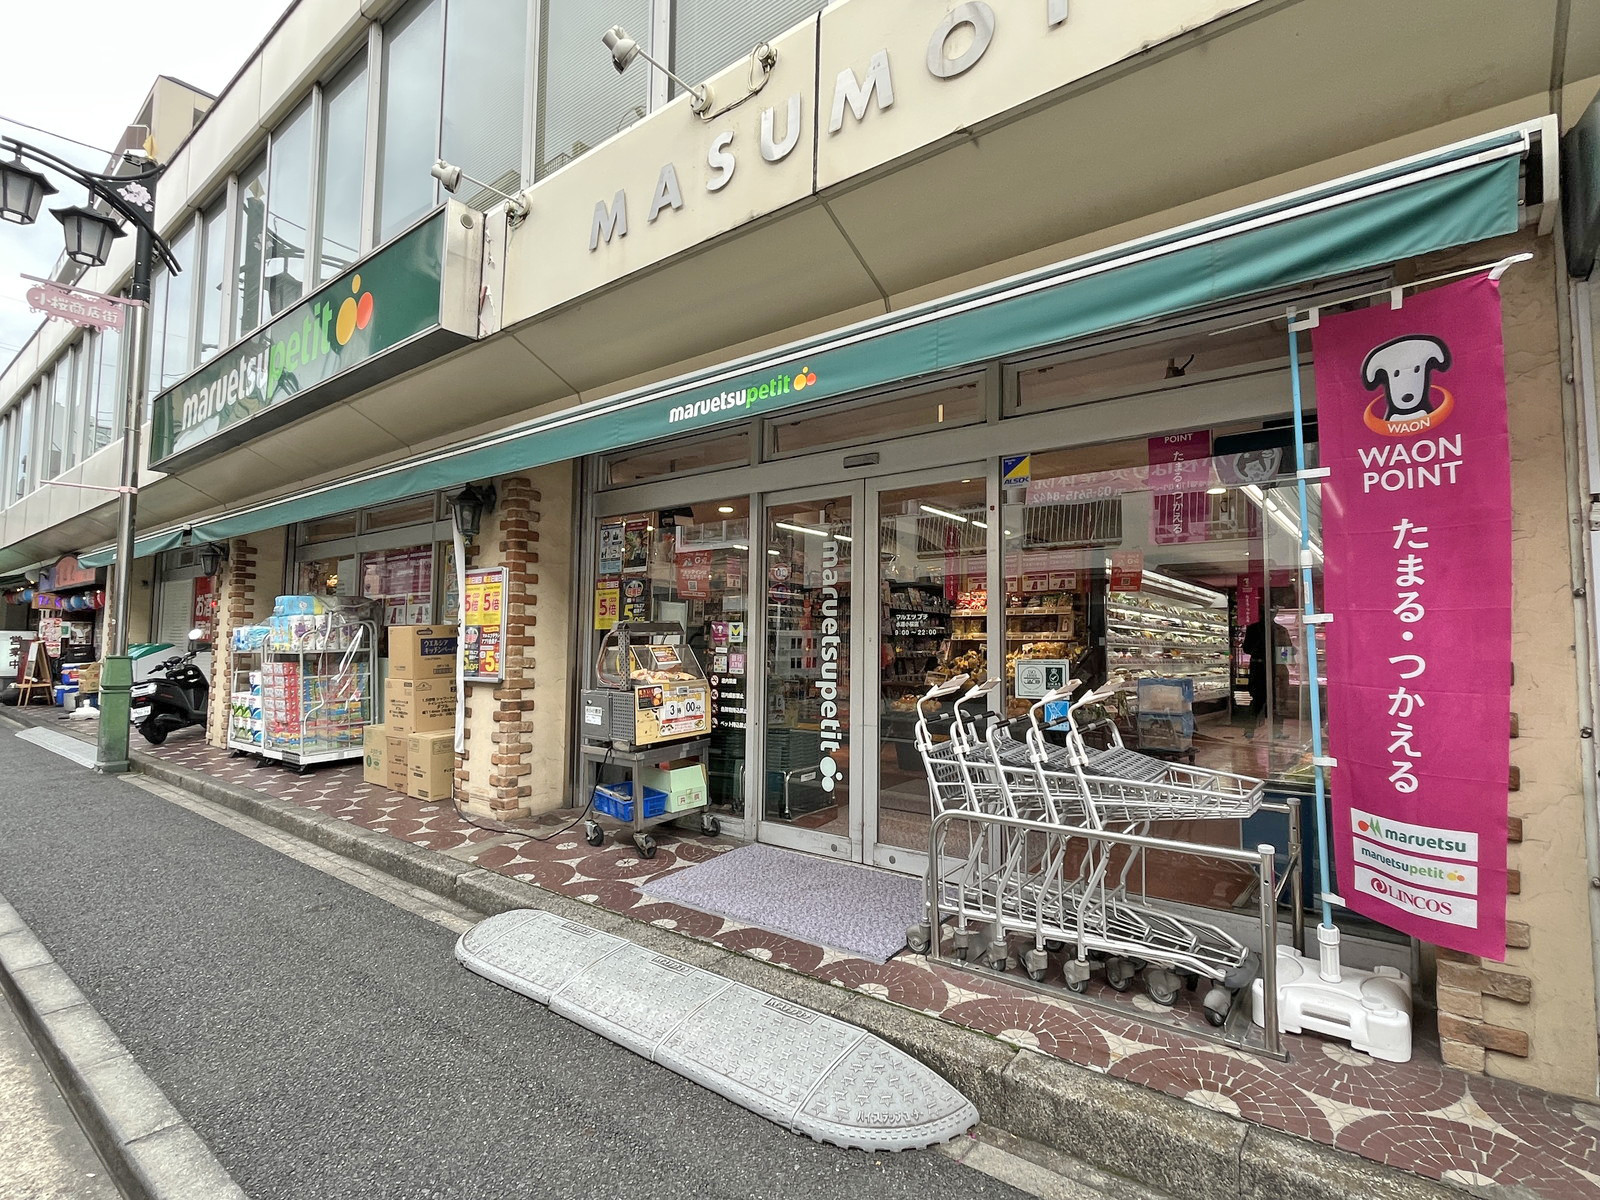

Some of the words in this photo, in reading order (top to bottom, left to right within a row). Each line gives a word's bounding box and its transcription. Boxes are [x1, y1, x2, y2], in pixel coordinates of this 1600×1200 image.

[588, 0, 1068, 251] MASUMO
[34, 292, 118, 324] 小桜商店街
[668, 374, 791, 423] maruetsupetit
[1164, 433, 1193, 444] POINT
[1387, 417, 1431, 434] WAON
[1358, 434, 1462, 469] WAON
[1004, 476, 1029, 485] ALSOK
[1363, 460, 1463, 493] POINT
[423, 639, 449, 647] ウエルシア
[815, 541, 842, 752] maruetsupetit
[1387, 518, 1429, 794] たまる・つかえる
[669, 704, 675, 715] 3
[685, 701, 696, 712] 00
[1385, 828, 1466, 852] maruetsu
[1361, 847, 1444, 879] maruetsupetit
[1388, 885, 1452, 915] LINCOS
